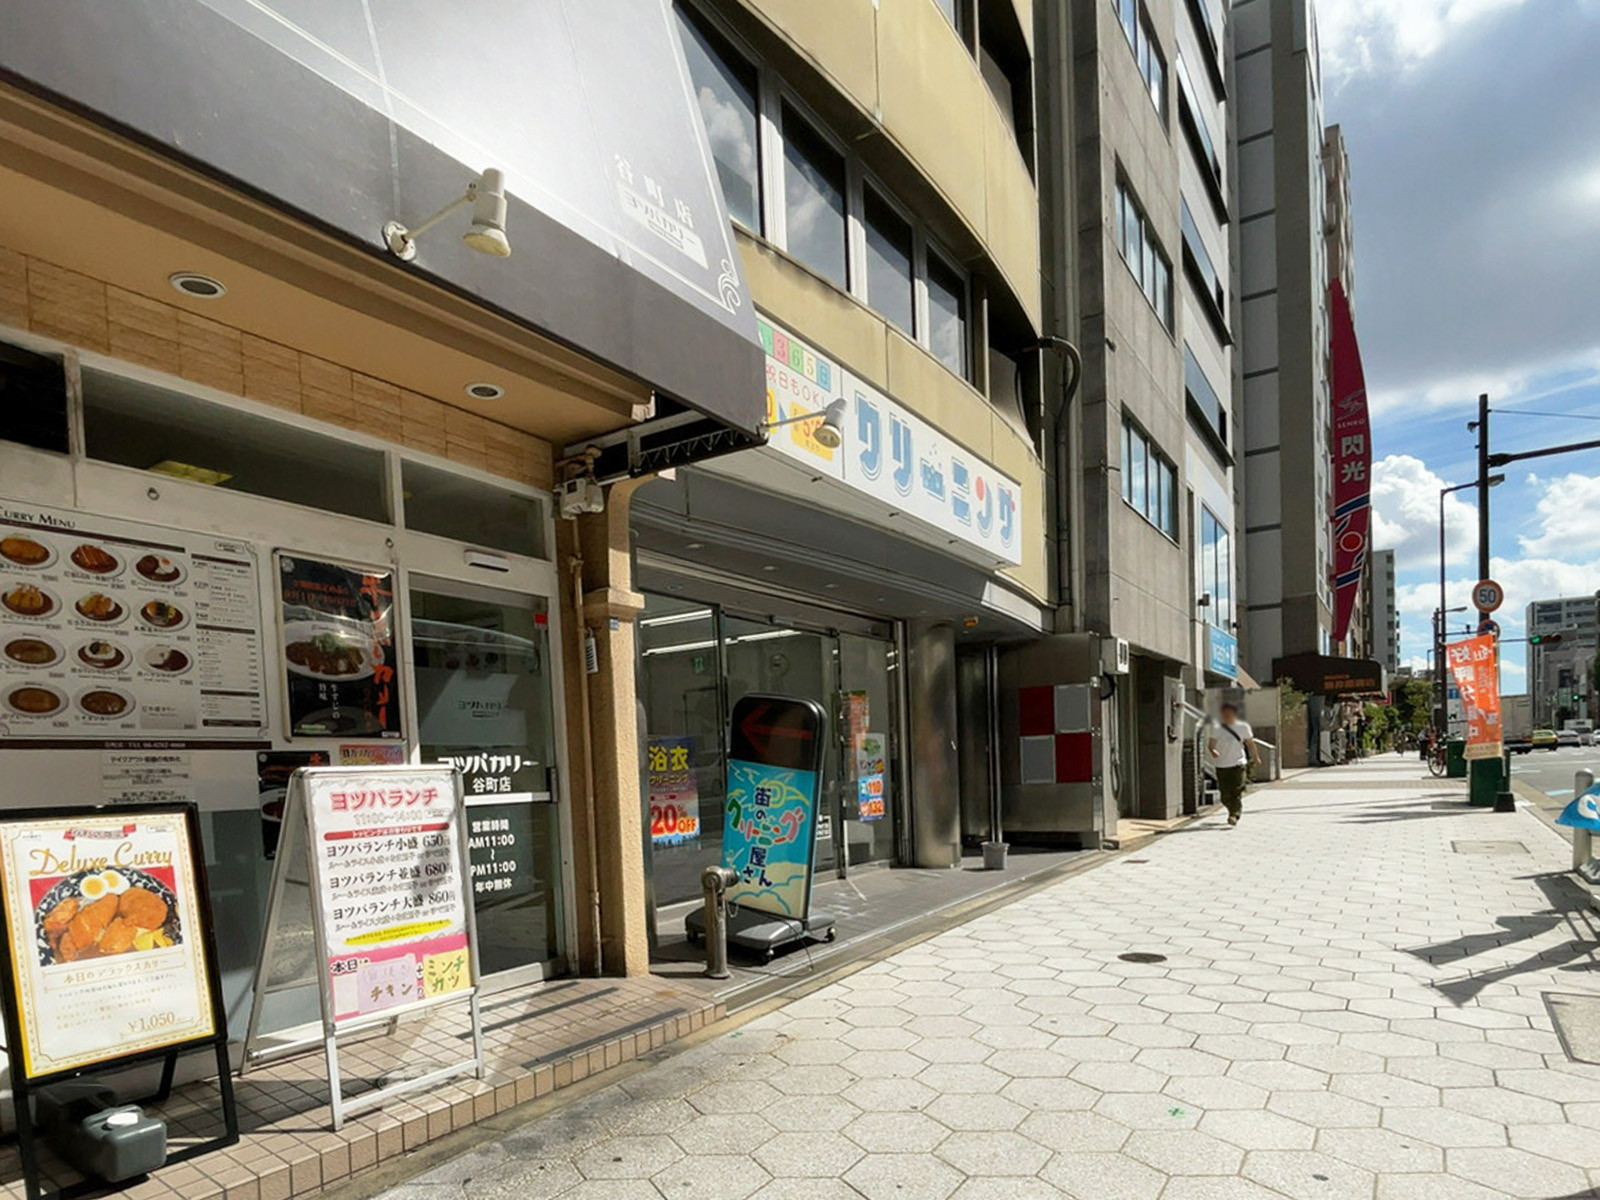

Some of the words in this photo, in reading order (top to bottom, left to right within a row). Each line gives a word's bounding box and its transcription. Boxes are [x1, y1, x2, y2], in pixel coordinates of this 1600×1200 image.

[1341, 434, 1366, 483] 閃光
[0, 505, 34, 522] URRY
[1479, 587, 1497, 604] 50
[649, 746, 689, 771] 浴衣
[472, 777, 512, 792] 谷町店
[330, 787, 438, 811] ヨツバランチ
[754, 786, 771, 820] 街の
[472, 819, 510, 833] 営業時間
[326, 837, 418, 857] ヨツバランチ小盛
[468, 833, 515, 848] AM11:00
[29, 845, 108, 876] Deluxe
[114, 842, 173, 868] Curry
[470, 860, 517, 877] PM11:00
[742, 846, 772, 887] 屋さん
[329, 865, 421, 889] ヨツバランチ並盛
[475, 878, 513, 893] 年中無休
[333, 894, 424, 920] ヨツバランチ大盛
[427, 955, 465, 976] ミンチ
[371, 983, 413, 1002] チキン
[432, 974, 460, 993] カツ
[127, 1011, 176, 1033] ¥1,050
